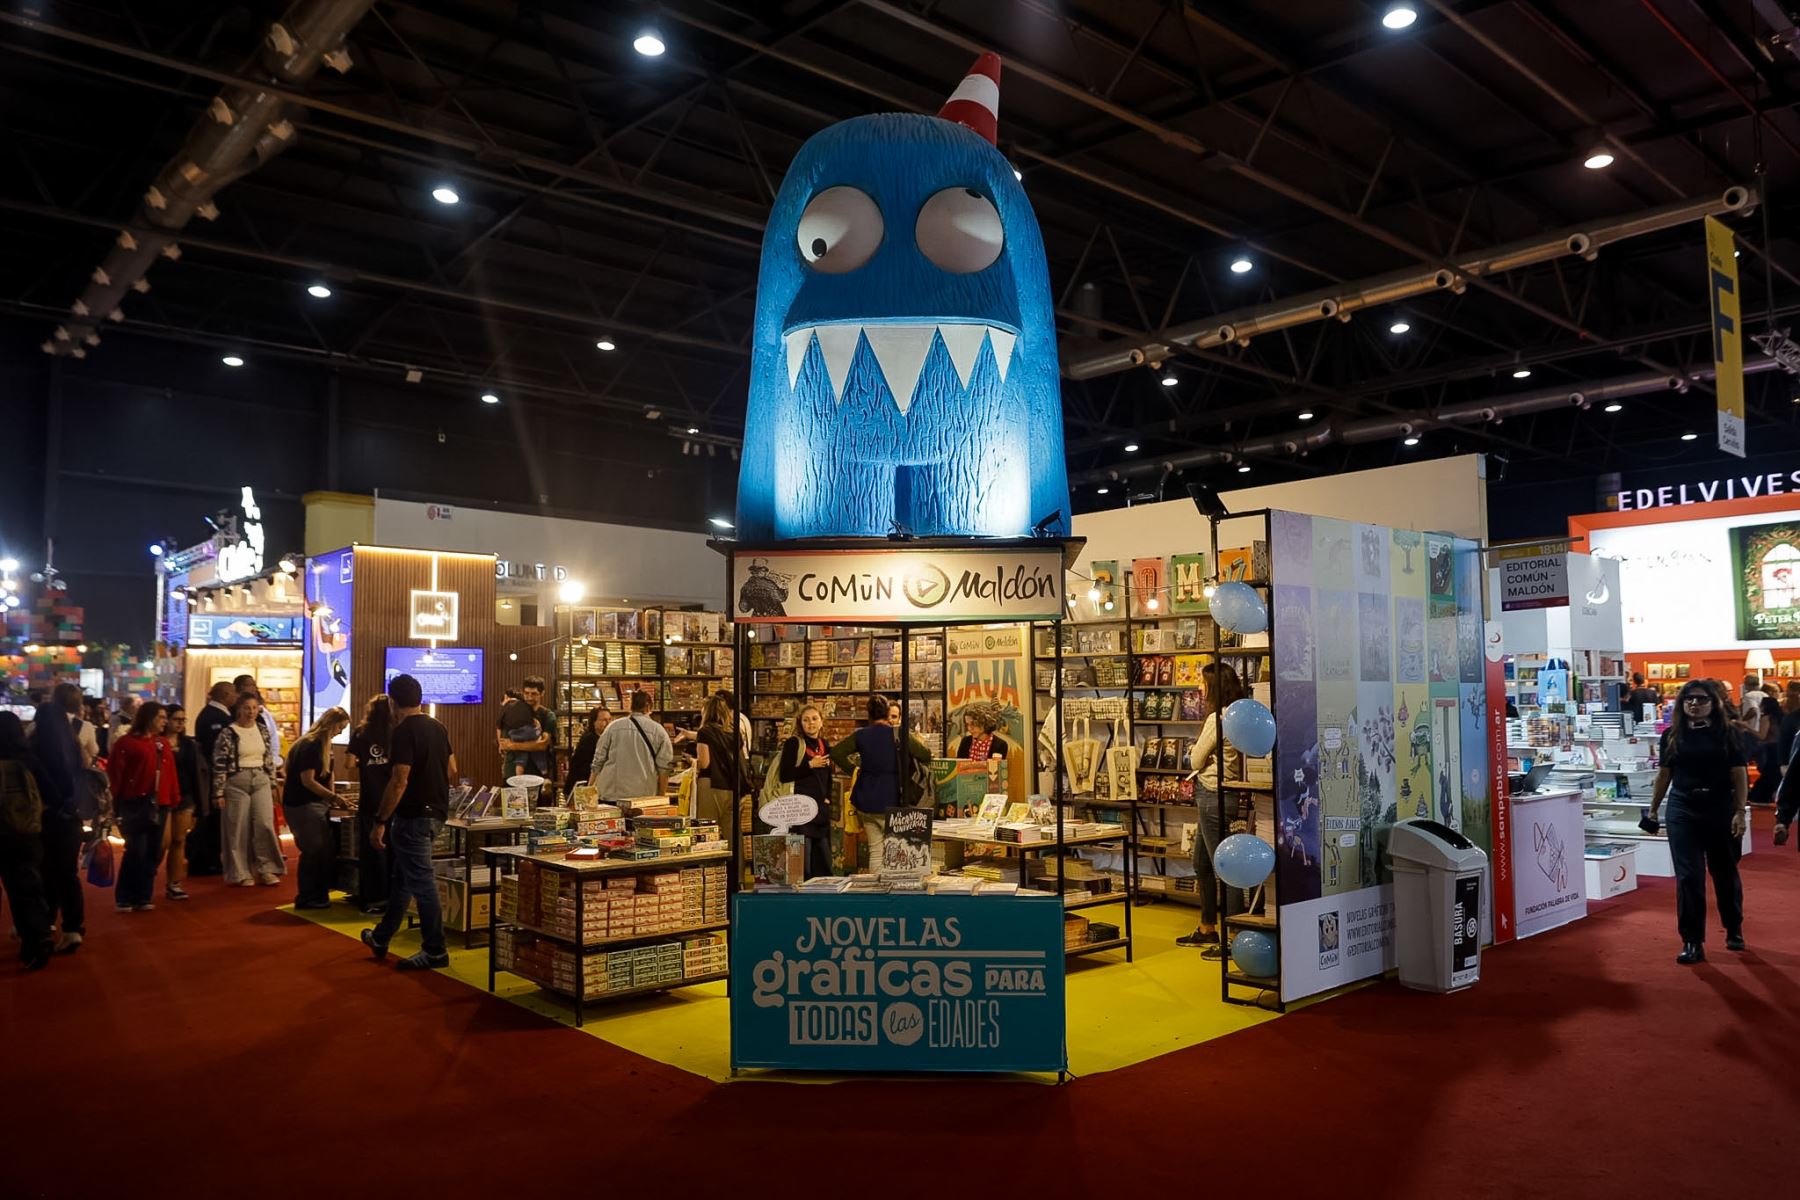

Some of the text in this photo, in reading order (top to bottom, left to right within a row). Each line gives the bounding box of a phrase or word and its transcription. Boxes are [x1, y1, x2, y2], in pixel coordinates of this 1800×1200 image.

[1617, 470, 1800, 512] EDELVIVES
[950, 563, 1056, 606] Maldón
[1506, 558, 1561, 572] EDITORIAL
[1507, 570, 1548, 584] COMÚN
[1508, 583, 1555, 597] MALDÓN
[949, 659, 1020, 706] CAJA
[1494, 709, 1507, 881] www.sanpablo.com.ar
[796, 917, 962, 953] NOVELAS
[1454, 901, 1463, 945] BASURA
[752, 947, 1046, 1008] gráficas PARA
[794, 999, 1000, 1049] TODAS las EDADES
